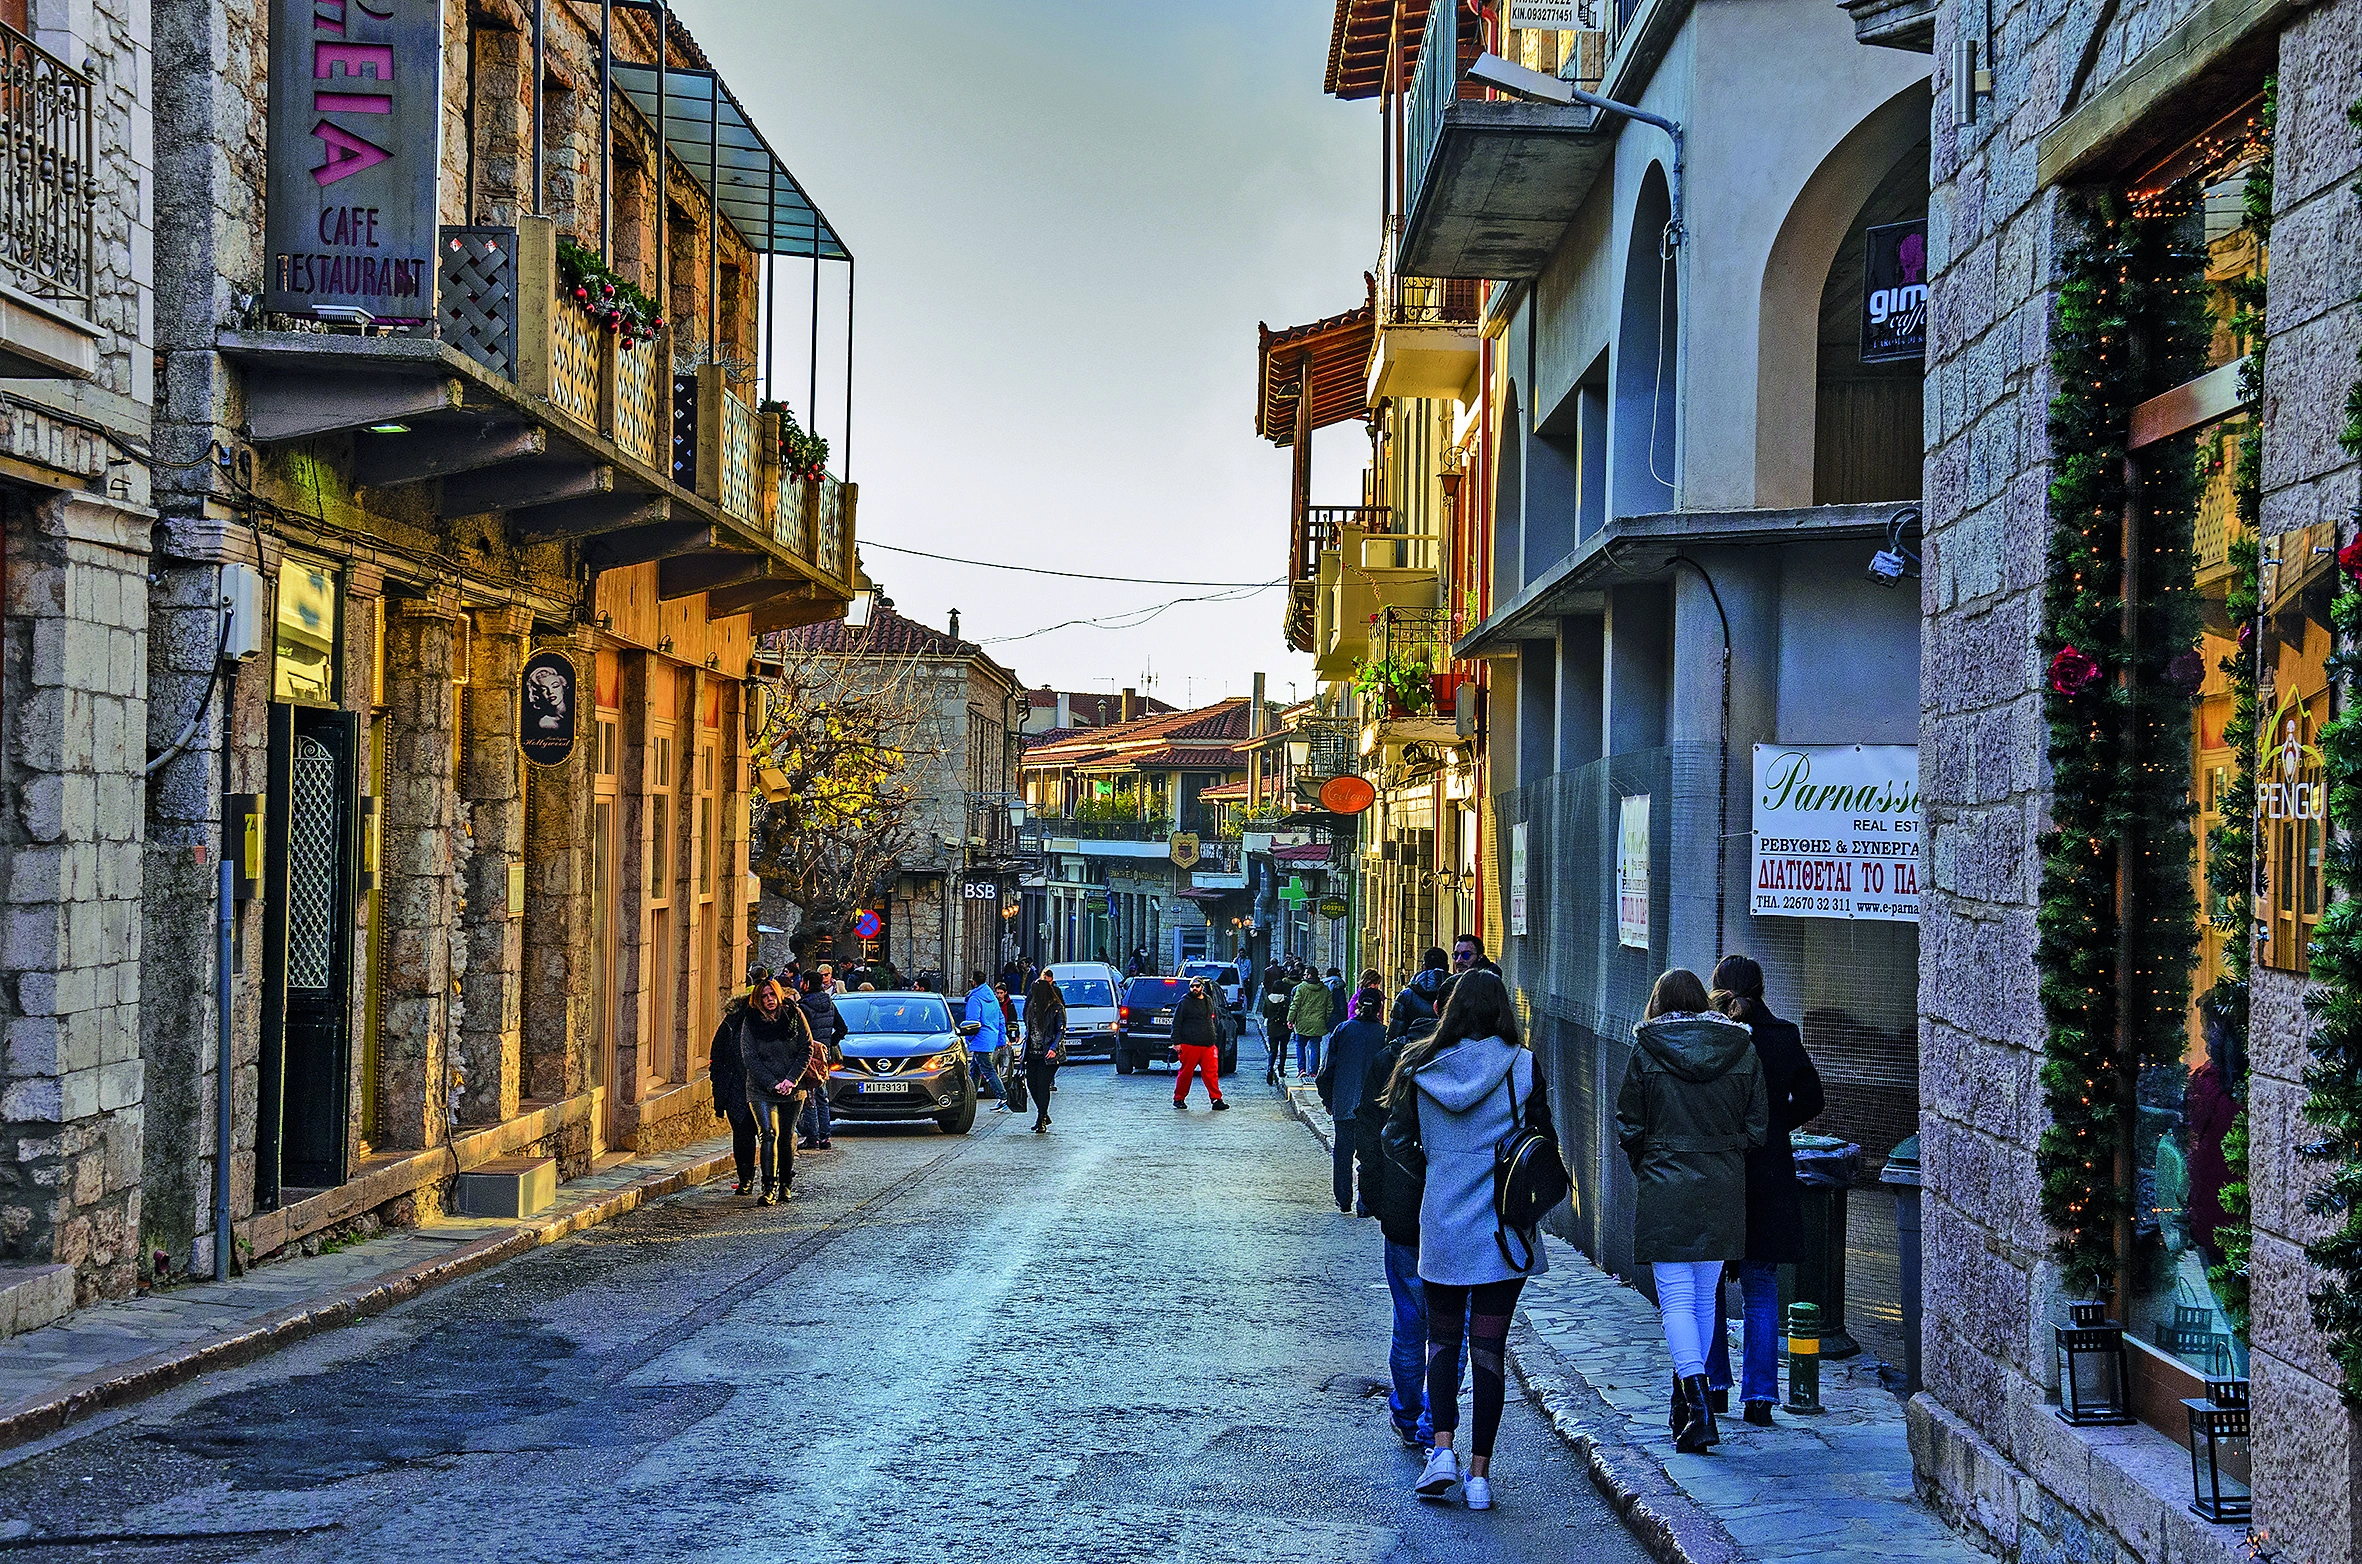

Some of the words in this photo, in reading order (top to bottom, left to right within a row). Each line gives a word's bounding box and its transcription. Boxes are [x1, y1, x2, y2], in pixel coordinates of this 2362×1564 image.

[318, 206, 380, 247] CAFE
[275, 252, 426, 298] RESTAURANT
[2257, 782, 2326, 820] PENGU
[1853, 819, 1888, 831] REAL
[1894, 820, 1919, 832] EST
[1761, 838, 1831, 853] ΡΕΒΥΘΗΣ
[1836, 840, 1848, 853] &
[1852, 841, 1919, 856] ΣΥΝΕΡΓΑ
[1758, 859, 1851, 892] ΔΙΑΤΙΘΕΤΑΙ
[1861, 861, 1884, 893] ΤΟ
[964, 883, 996, 899] BSB
[1756, 895, 1780, 909] ΤΗΛ.
[1783, 896, 1814, 910] 22670
[1817, 897, 1829, 911] 32
[1832, 898, 1851, 912] 311
[1857, 902, 1919, 917] www.e-parna
